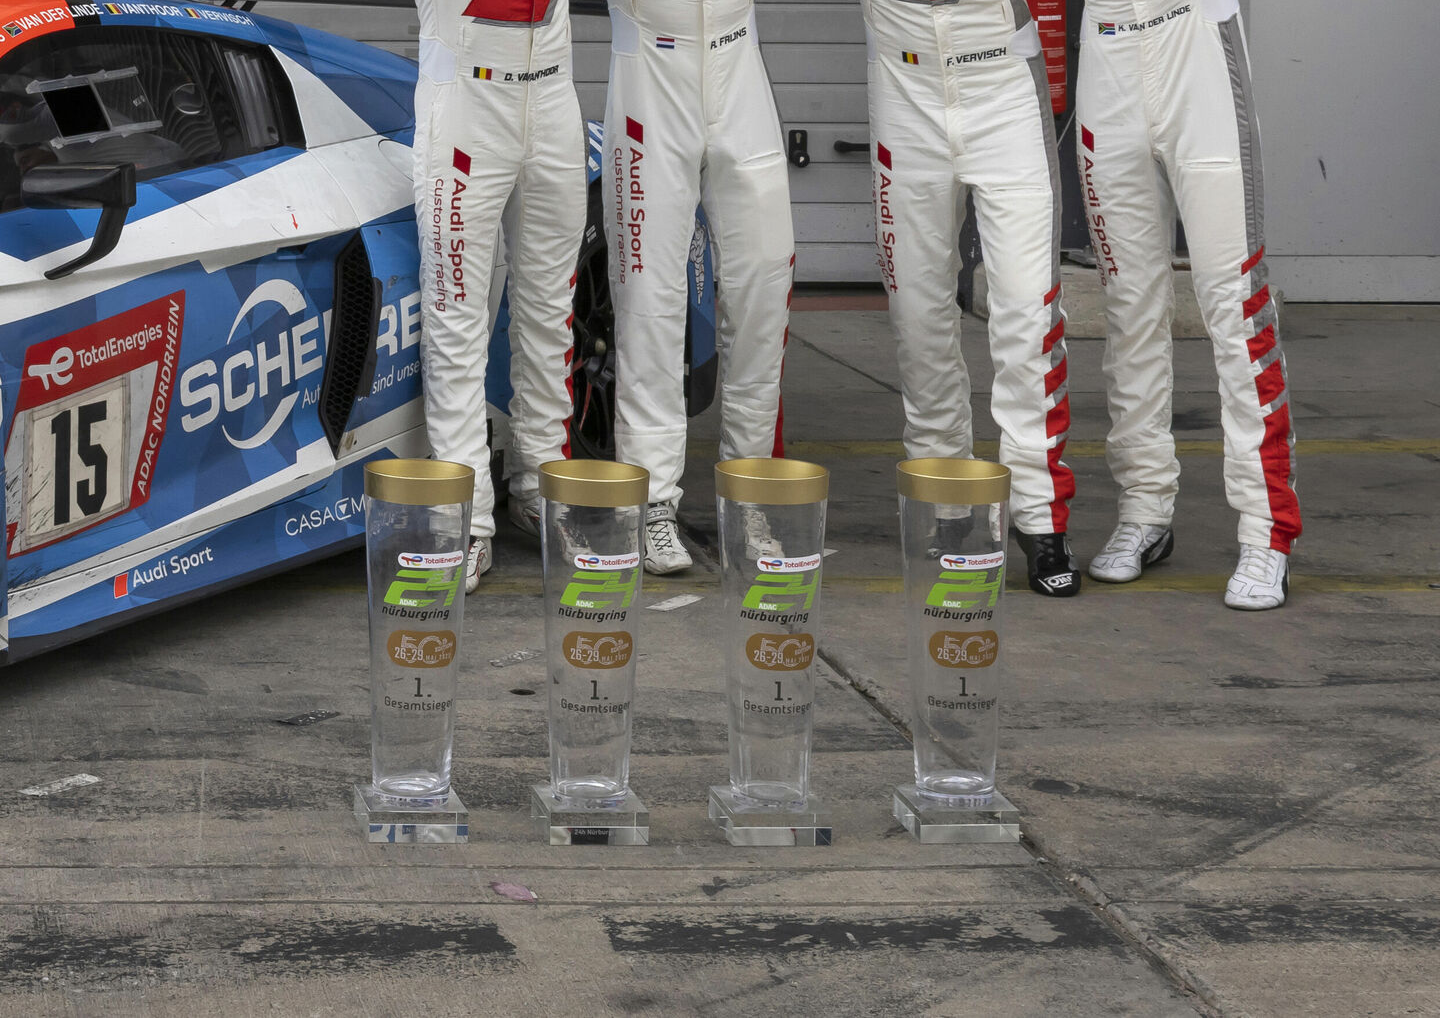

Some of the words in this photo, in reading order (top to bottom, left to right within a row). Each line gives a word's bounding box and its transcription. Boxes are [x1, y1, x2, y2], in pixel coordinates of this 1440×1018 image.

[16, 12, 48, 30] VAN
[44, 7, 67, 24] DER
[67, 3, 104, 17] LINDE
[121, 2, 181, 18] VANTHOOR
[200, 9, 255, 26] VERVISCH
[719, 27, 747, 47] FRIJNS
[1128, 23, 1145, 32] VAN
[1147, 16, 1164, 29] DER
[1167, 4, 1191, 21] LINDE
[956, 47, 1007, 64] VERVISCH
[614, 147, 625, 228] customer
[629, 146, 645, 201] Audi
[1084, 155, 1101, 207] Audi
[433, 178, 445, 259] customer
[451, 178, 467, 232] Audi
[880, 172, 894, 226] Audi
[615, 233, 627, 284] racing
[627, 207, 645, 274] Sport
[883, 231, 898, 294] Sport
[1092, 213, 1119, 276] Sport
[435, 263, 449, 312] racing
[448, 239, 467, 302] Sport
[76, 324, 163, 368] TotalEnergies
[137, 433, 159, 497] ADAC
[152, 299, 181, 431] NORDRHEIN
[372, 365, 395, 394] sind
[51, 400, 107, 526] 15
[133, 561, 179, 588] Audi
[182, 546, 214, 578] Sport
[382, 605, 450, 622] nürburgring
[399, 599, 417, 607] ADAC
[558, 607, 627, 623] nürburgring
[576, 600, 594, 608] ADAC
[740, 610, 809, 625] nürburgring
[759, 603, 777, 611] ADAC
[924, 607, 993, 623] nürburgring
[942, 600, 961, 608] ADAC
